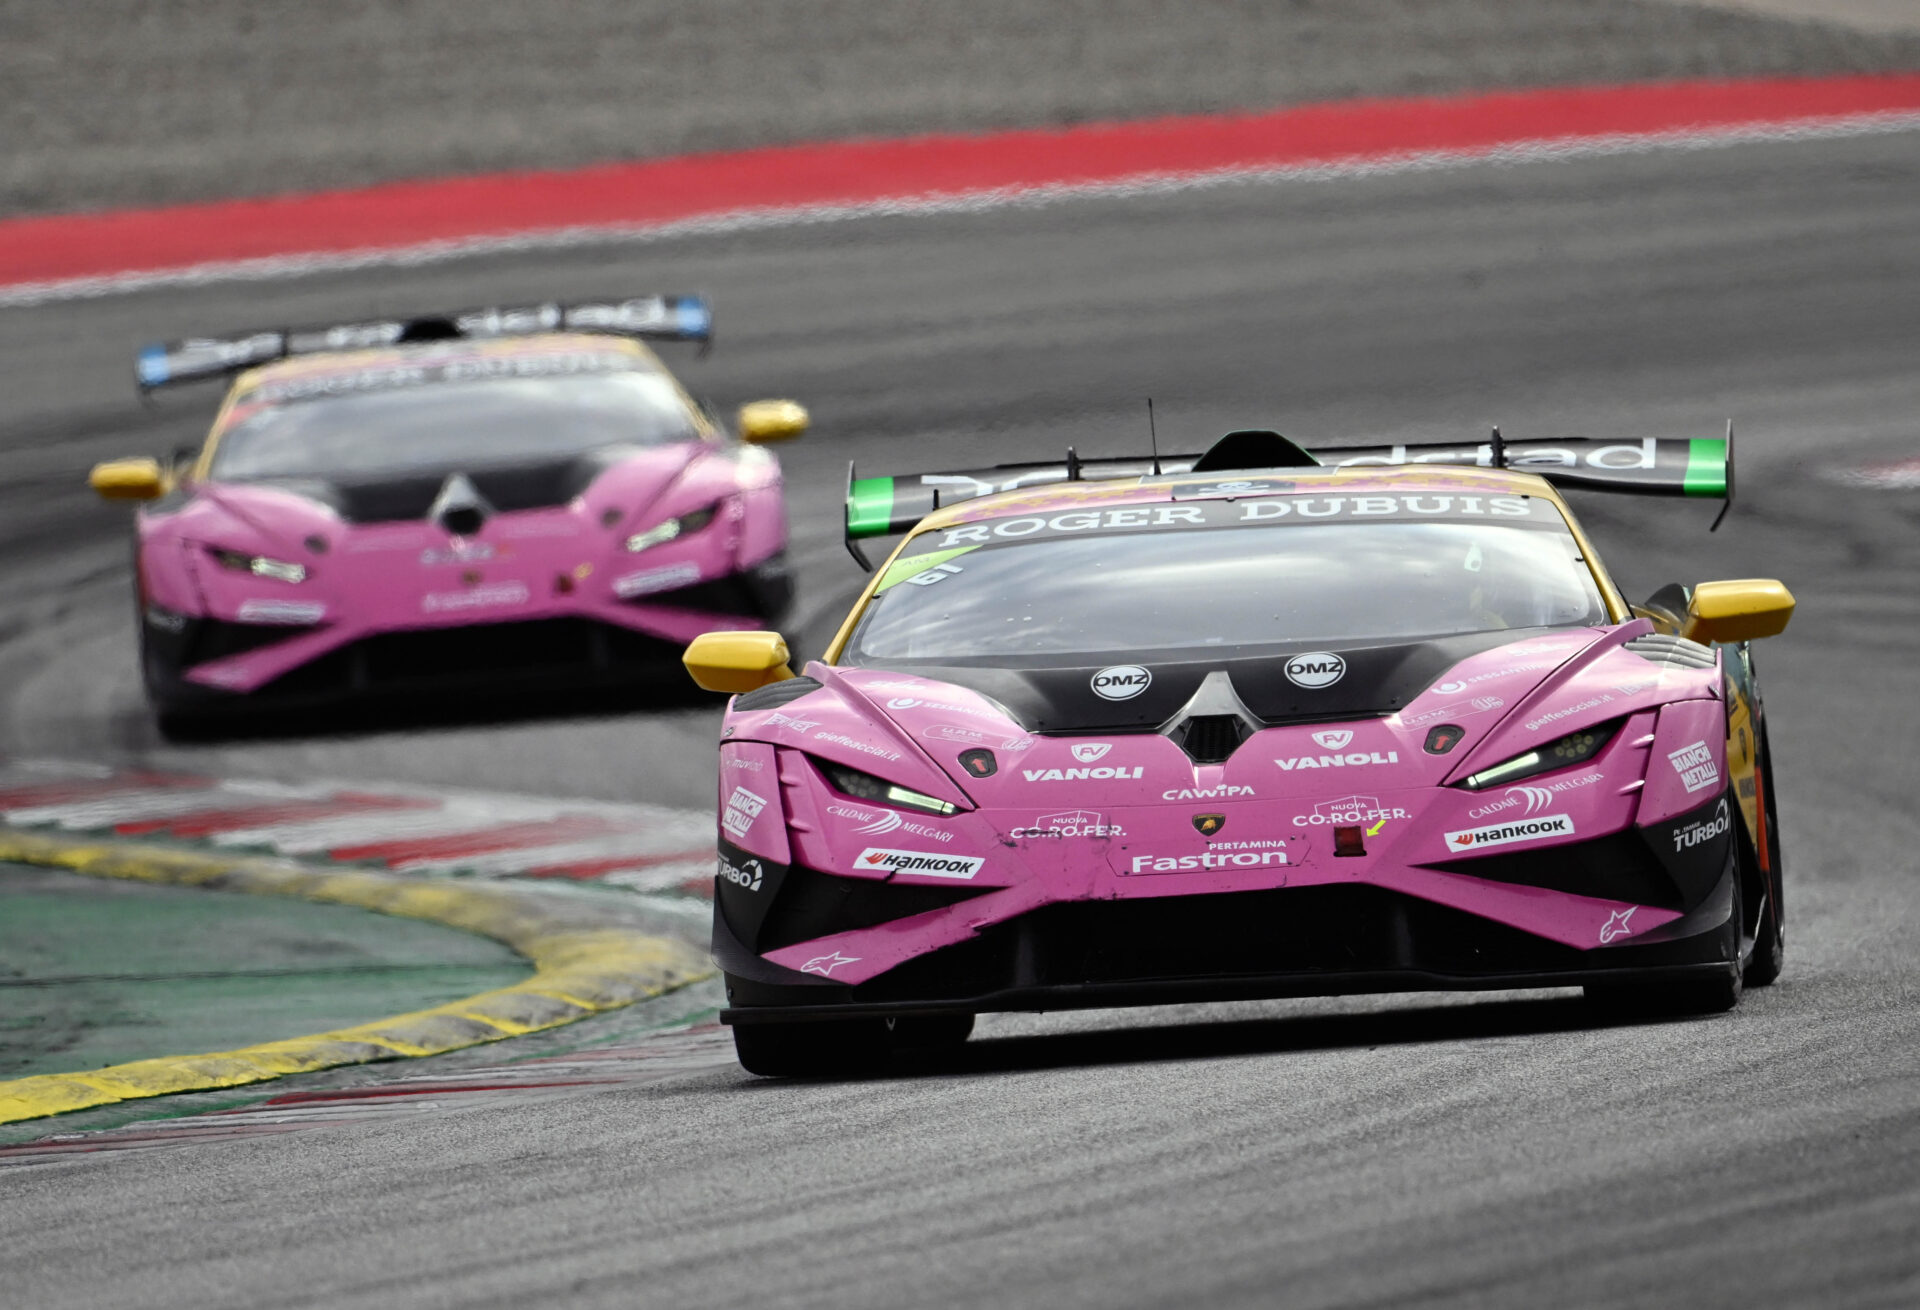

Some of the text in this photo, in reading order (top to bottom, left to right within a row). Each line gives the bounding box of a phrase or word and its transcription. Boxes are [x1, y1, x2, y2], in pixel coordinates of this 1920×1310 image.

[938, 496, 1531, 547] ROGER DUBUIS
[1288, 661, 1342, 675] OMZ
[1094, 674, 1149, 687] OMZ
[1274, 751, 1399, 771] VANOLI
[1022, 767, 1144, 782] VANOLI
[1331, 803, 1367, 811] NUOVA
[1469, 797, 1520, 819] CALDAIE
[826, 805, 954, 843] CALDAIE MELGARI
[1209, 840, 1287, 850] PERTAMINA
[1673, 817, 1724, 853] TURBO
[1132, 852, 1287, 873] Fastron
